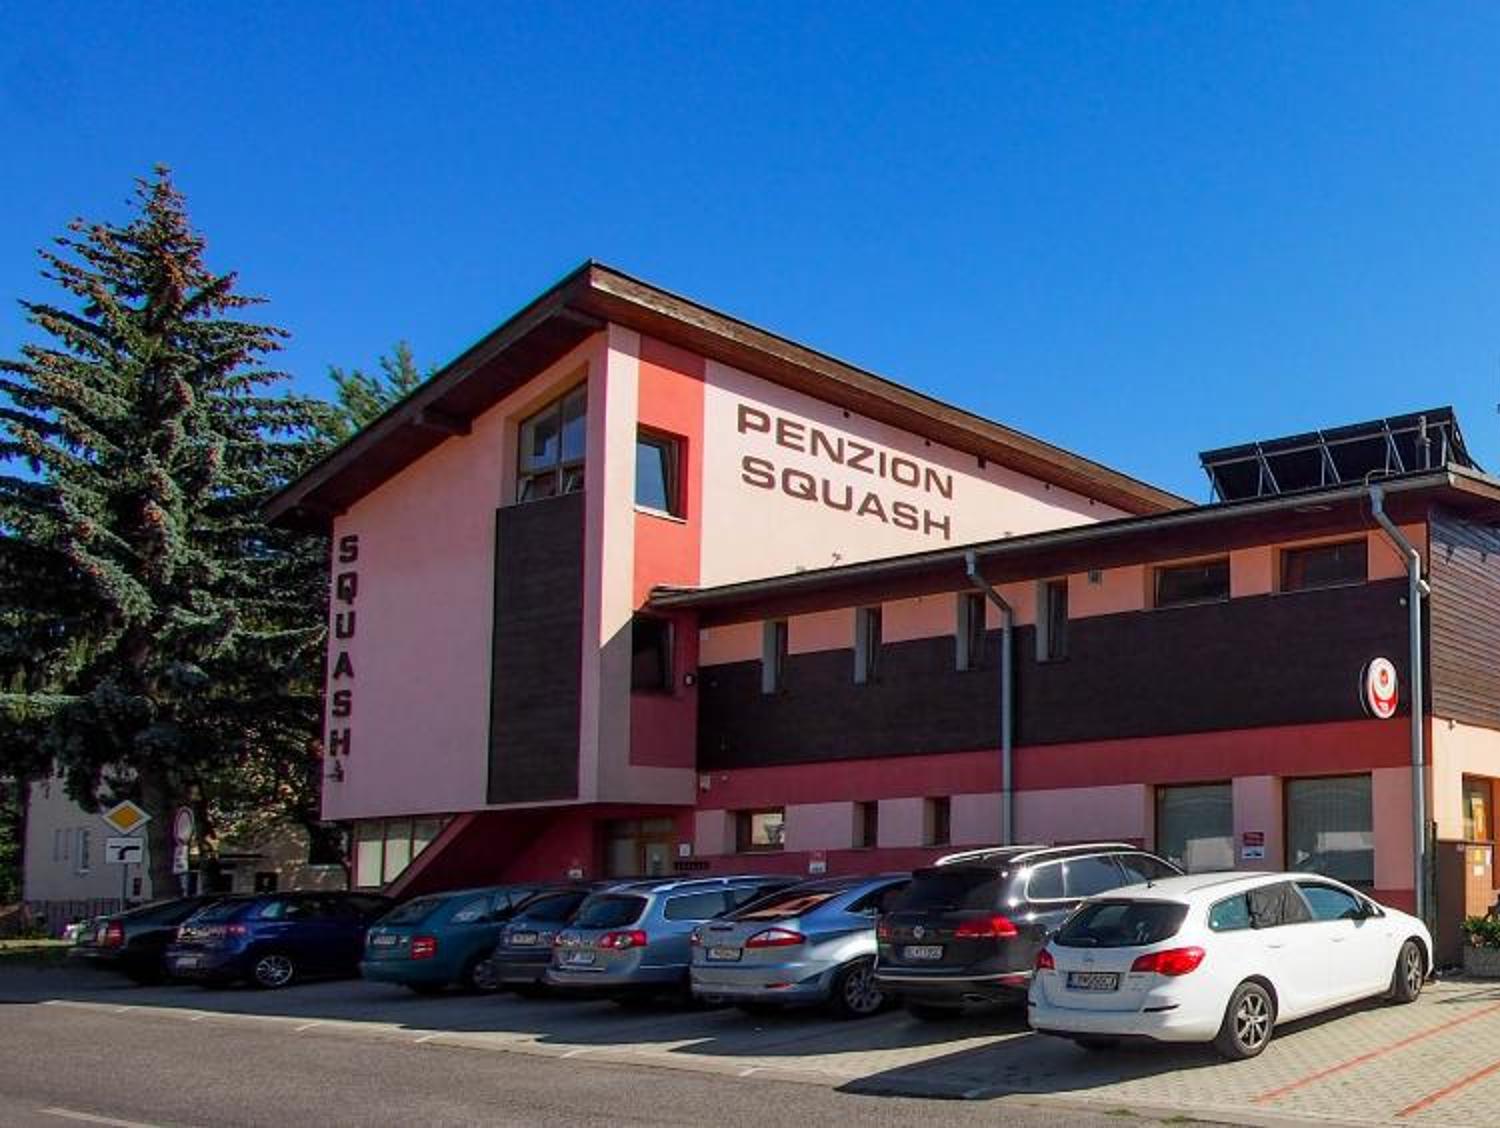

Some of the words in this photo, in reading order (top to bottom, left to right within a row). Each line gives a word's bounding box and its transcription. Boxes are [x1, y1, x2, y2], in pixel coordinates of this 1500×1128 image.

[737, 403, 953, 500] PENZION
[741, 455, 951, 540] SQUASH
[329, 534, 359, 757] SQUASH
